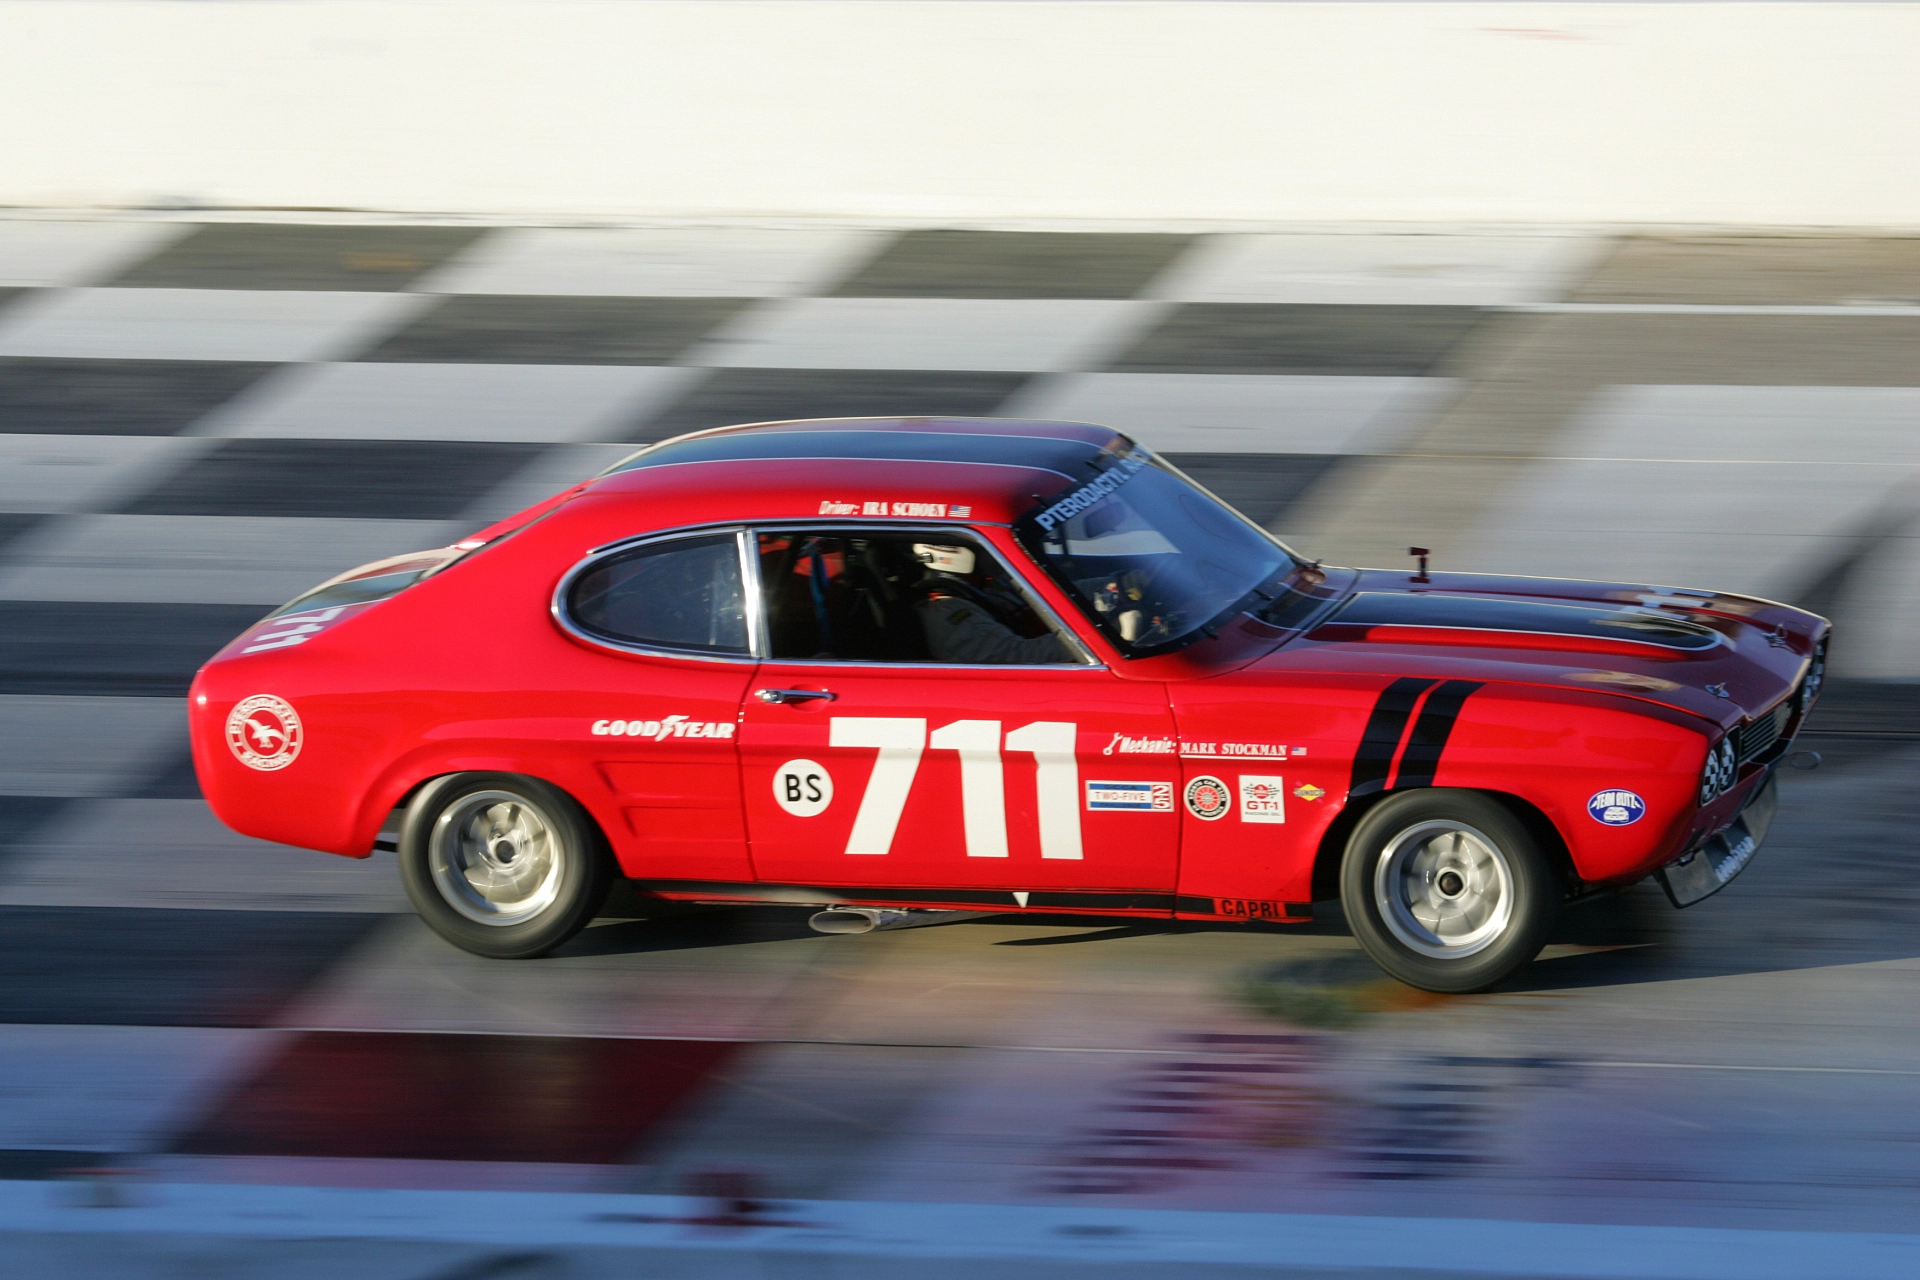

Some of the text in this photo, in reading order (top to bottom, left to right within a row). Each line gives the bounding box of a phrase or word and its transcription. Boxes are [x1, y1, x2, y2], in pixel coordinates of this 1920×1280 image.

[818, 500, 948, 517] Driver: IRA SCHOEN
[1034, 467, 1130, 531] PTERODACTYL
[591, 714, 736, 742] GOODYEAR
[1179, 742, 1217, 754] MARK
[1221, 743, 1288, 757] STOCKMAN
[785, 773, 822, 803] BS
[829, 716, 1084, 860] 711
[1246, 800, 1279, 811] GT-1
[1221, 899, 1279, 917] CAPRI
